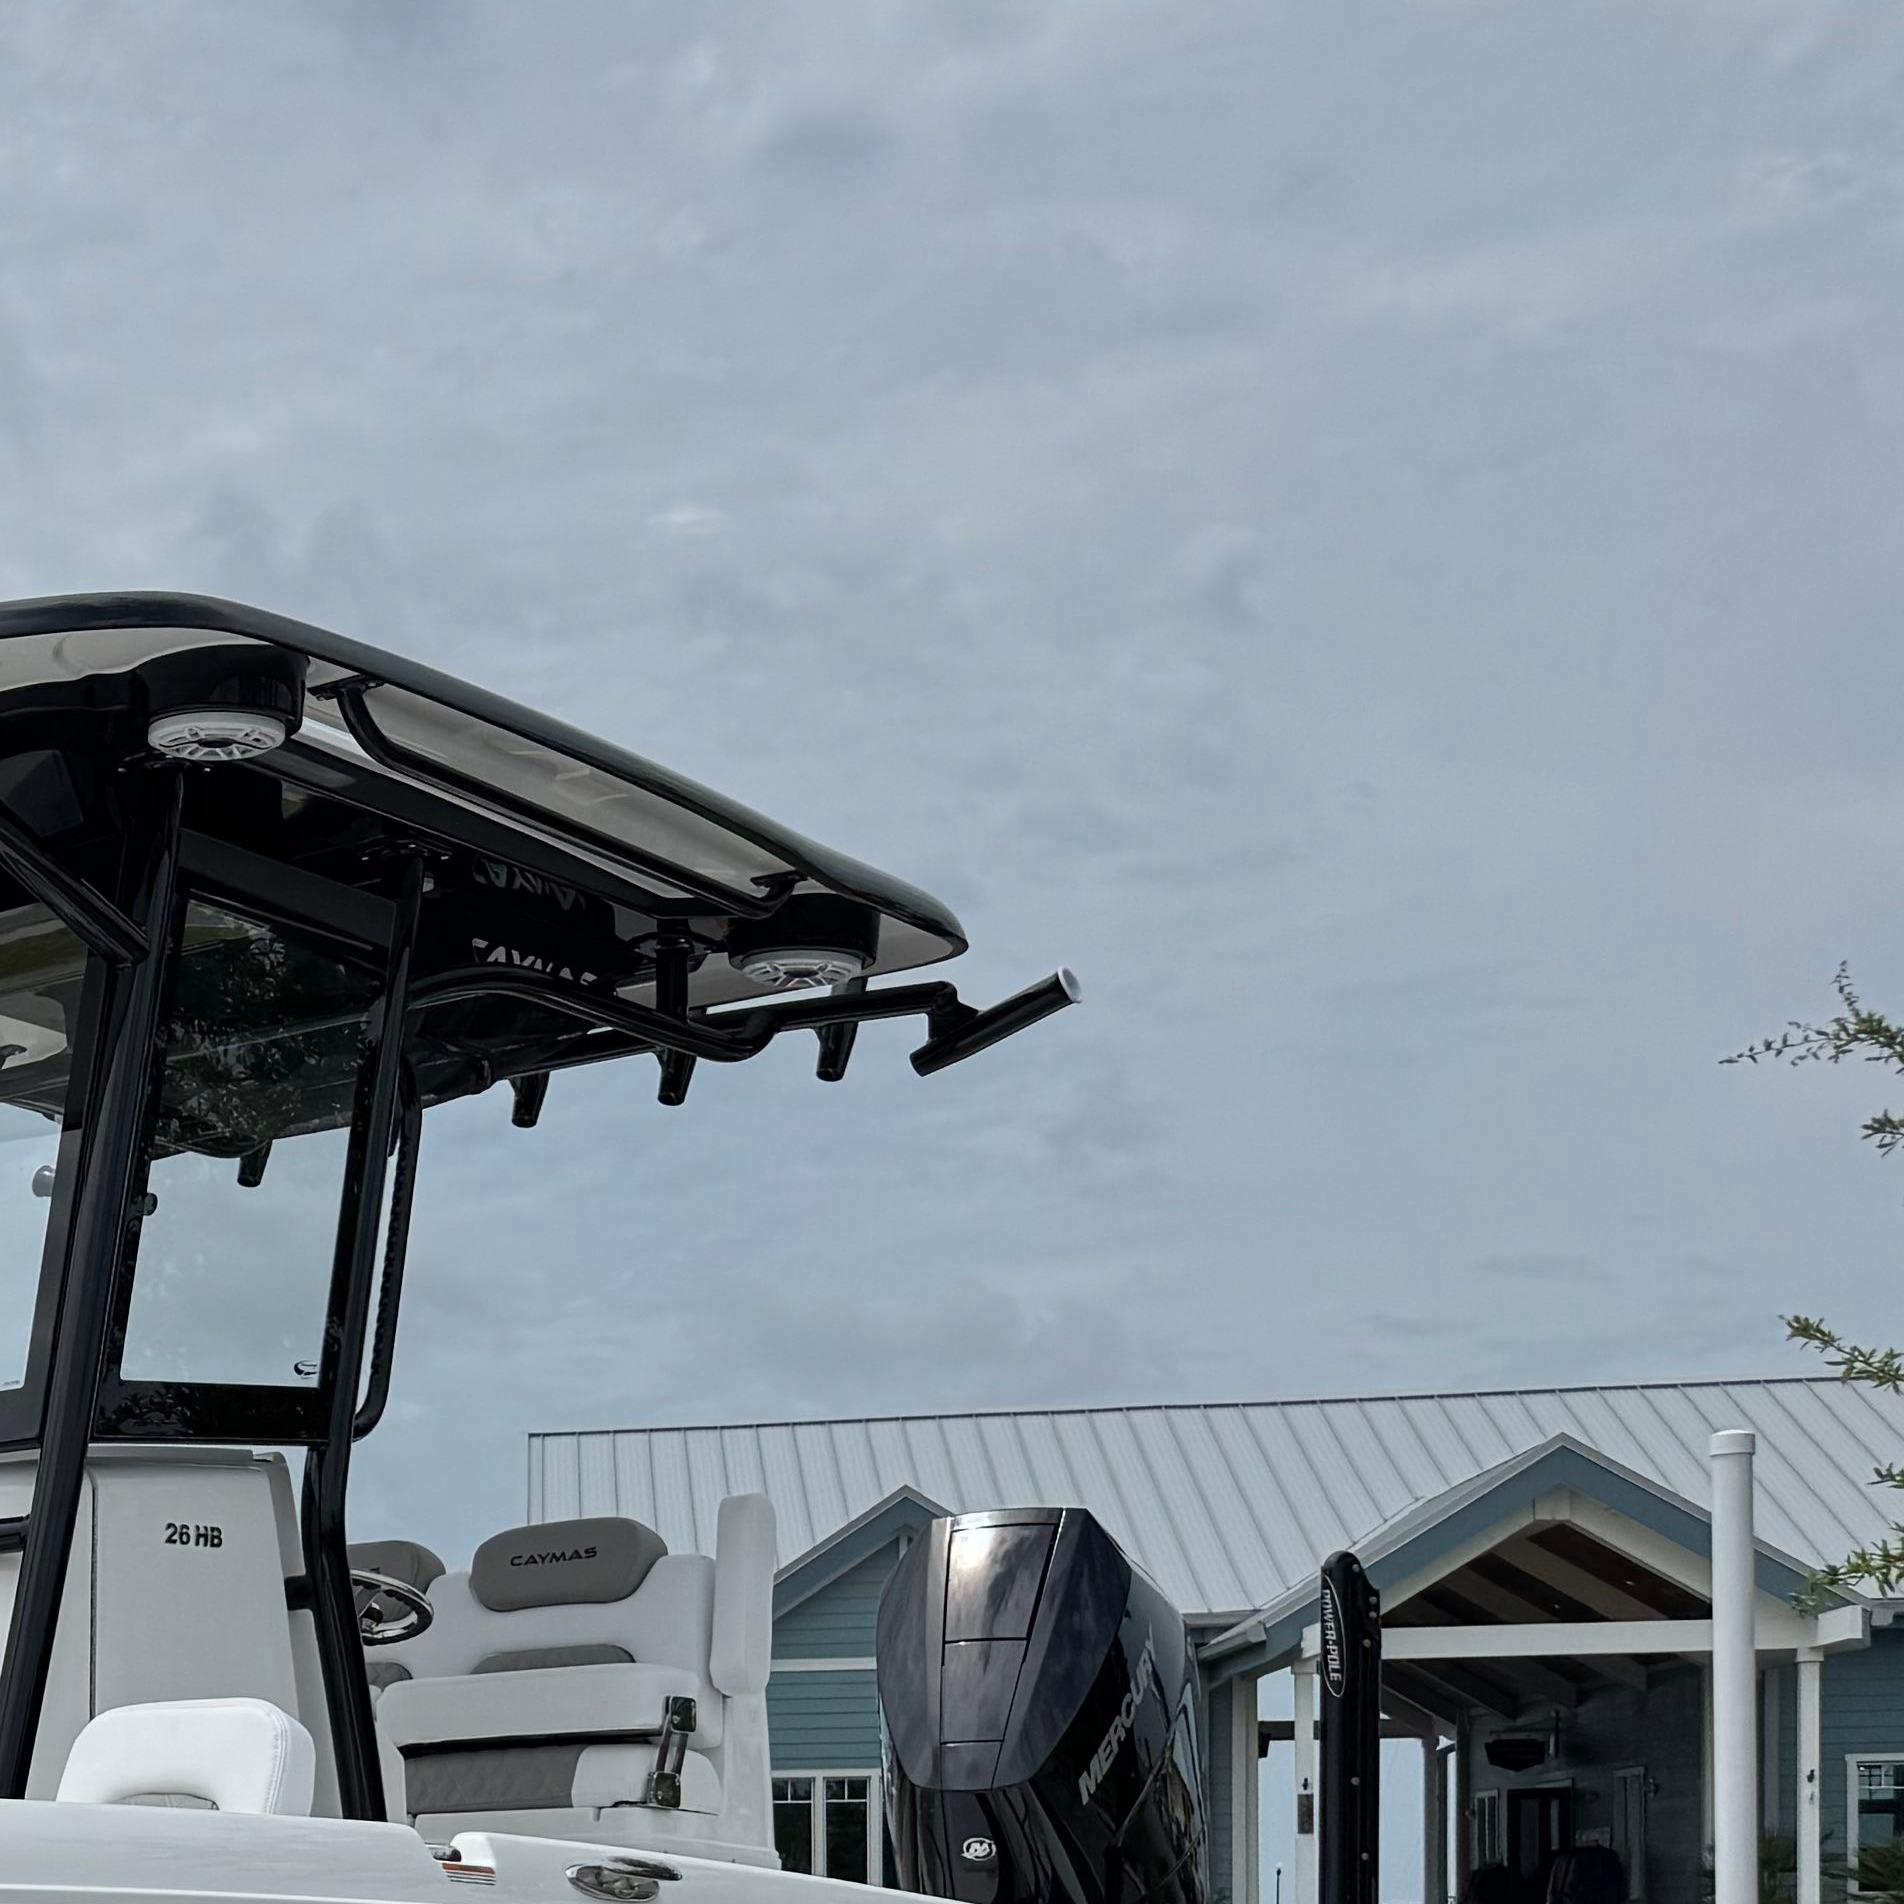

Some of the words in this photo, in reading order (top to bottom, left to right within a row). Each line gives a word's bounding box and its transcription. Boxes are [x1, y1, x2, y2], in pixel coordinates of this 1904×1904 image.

[165, 1523, 190, 1545] 26
[195, 1525, 223, 1548] HB
[510, 1547, 597, 1566] CAYMAS
